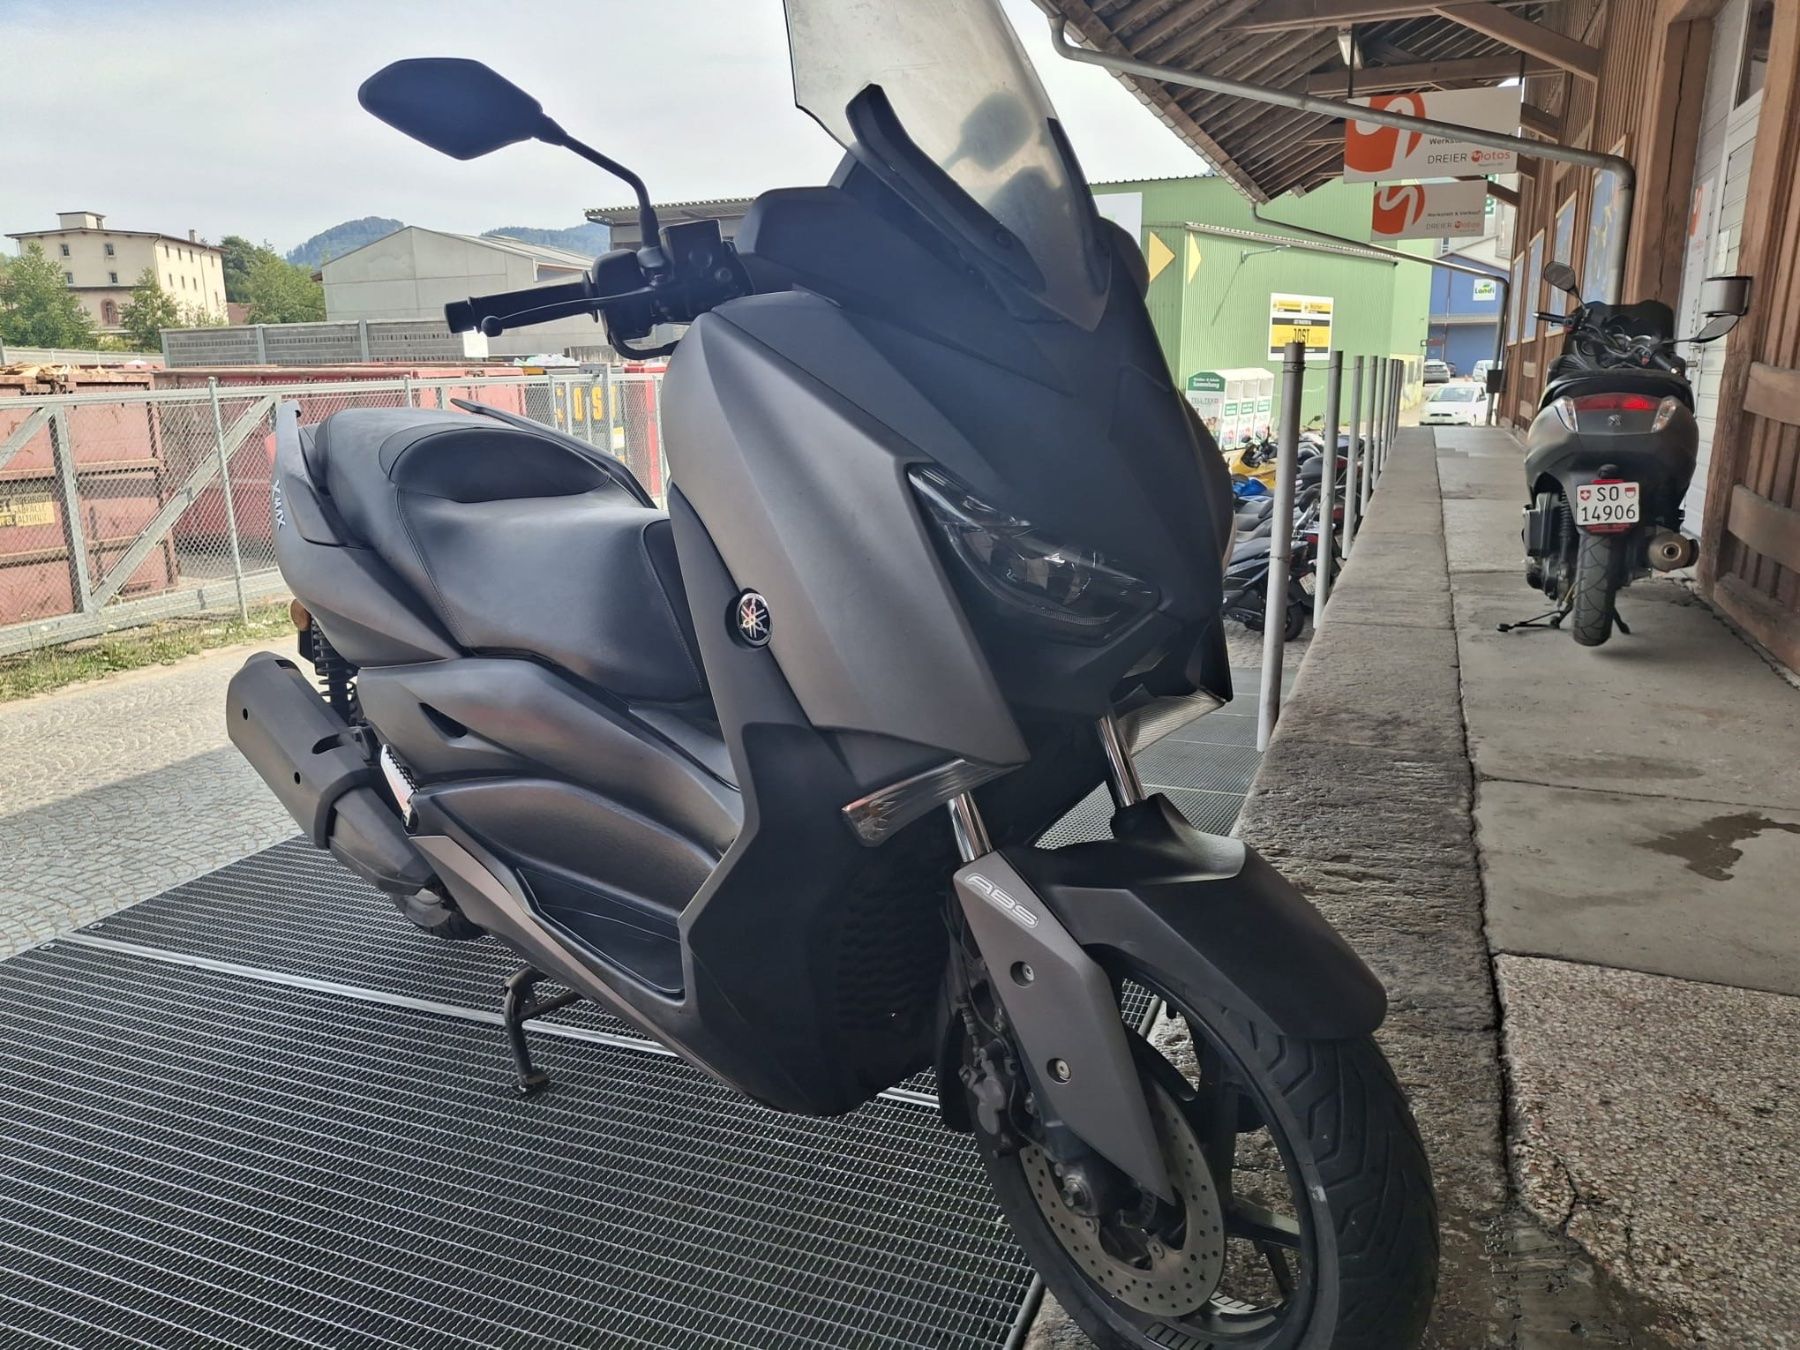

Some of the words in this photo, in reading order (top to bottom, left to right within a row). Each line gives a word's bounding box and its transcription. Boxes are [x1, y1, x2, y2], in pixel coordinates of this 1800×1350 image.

[1427, 152, 1467, 165] DREIER
[1597, 486, 1619, 501] SO
[1581, 504, 1636, 522] 14906
[967, 875, 1037, 925] ABS
